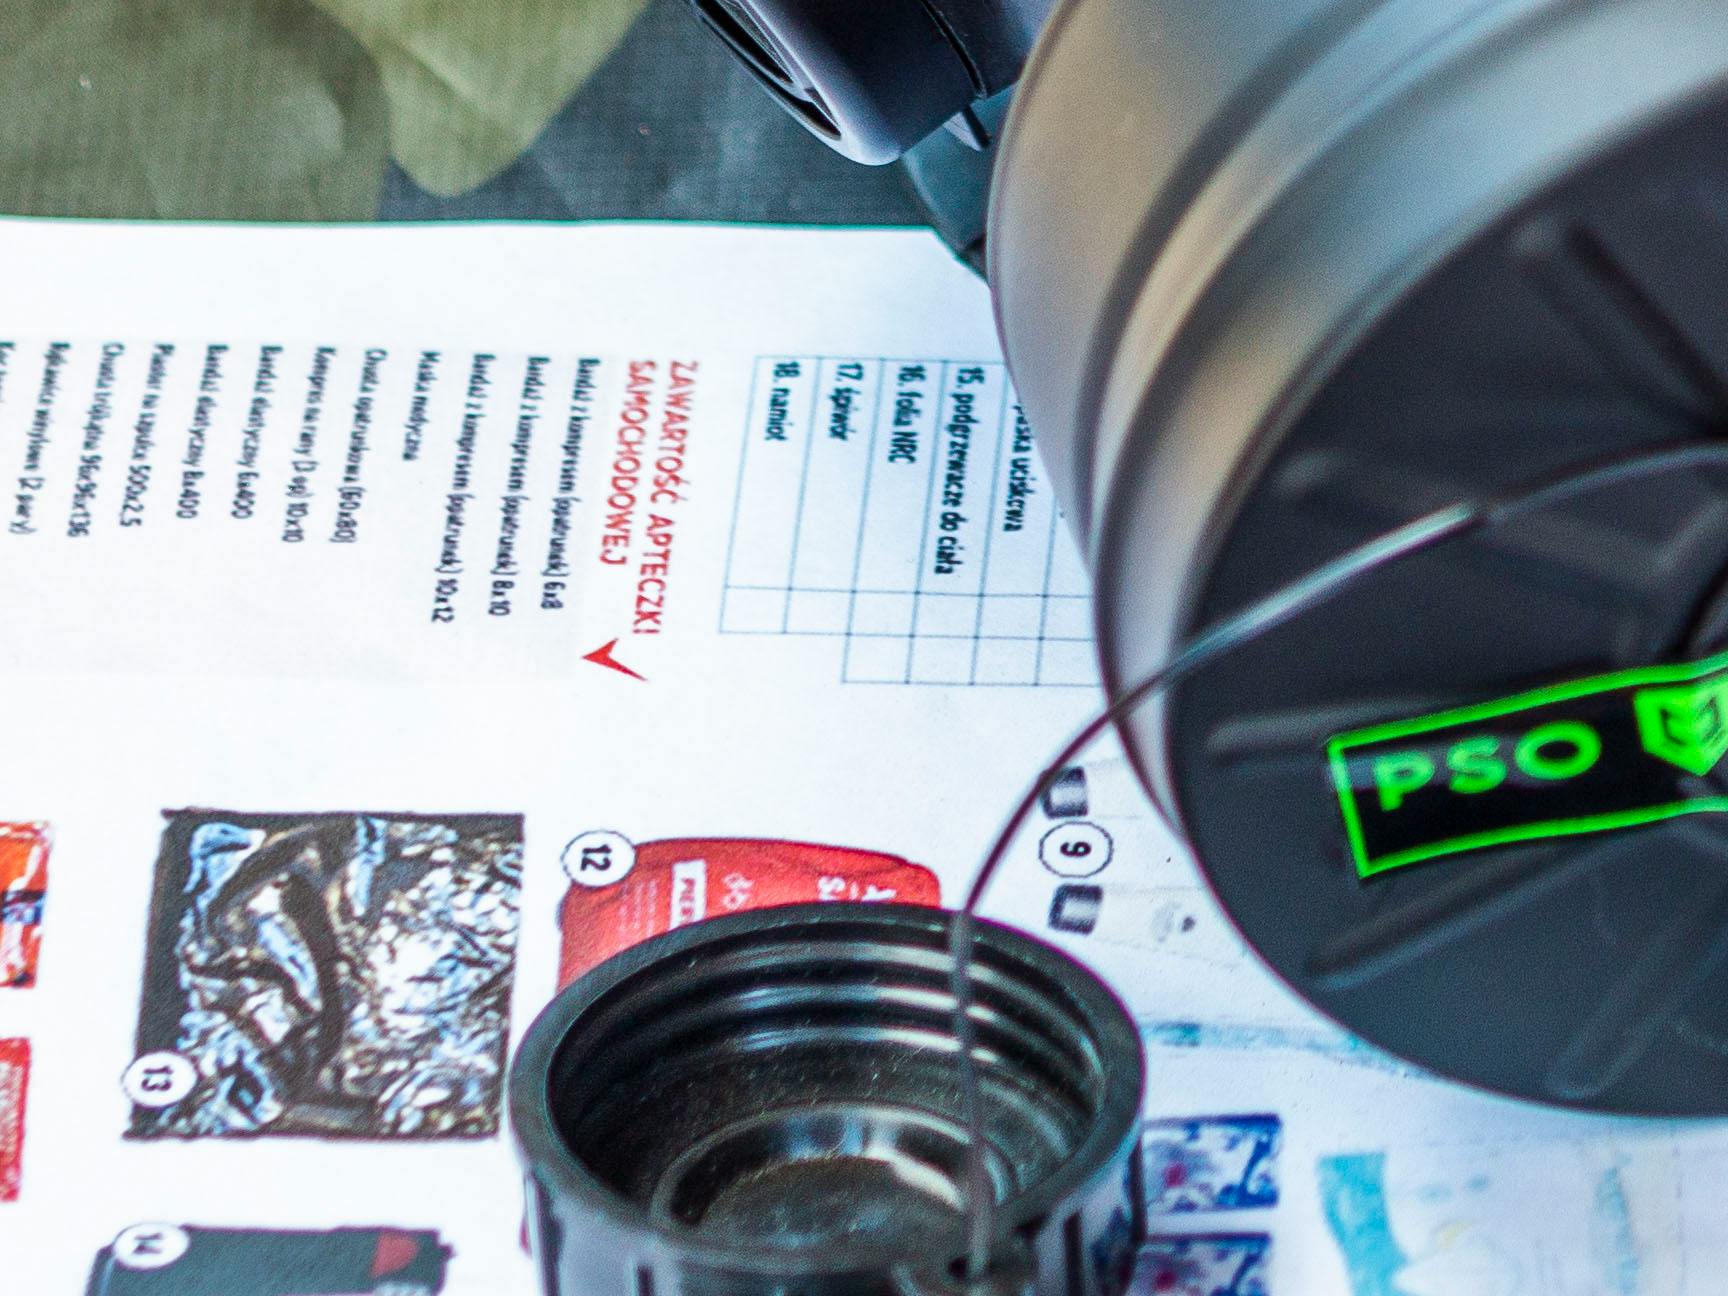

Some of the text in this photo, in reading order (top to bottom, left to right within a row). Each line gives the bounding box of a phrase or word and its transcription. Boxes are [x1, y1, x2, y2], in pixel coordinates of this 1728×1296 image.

[96, 342, 125, 388] Chusta
[200, 344, 229, 392] Bandaż
[254, 345, 283, 392] Bandaż
[307, 346, 336, 404] Kompres
[359, 349, 388, 393] Chusta
[415, 351, 440, 392] Maska
[467, 353, 496, 398] Bandaż
[522, 356, 550, 400] Bandaż
[572, 358, 601, 401] Bandaż
[303, 407, 320, 422] na
[465, 402, 482, 410] z
[765, 361, 800, 441] 18. namiot
[829, 362, 864, 441] 17. śpiwór
[888, 364, 926, 463] 16. folia NRC
[182, 396, 216, 467] elastyczny
[237, 396, 271, 468] elastyczny
[294, 425, 316, 456] rany
[453, 413, 484, 490] kompresem
[508, 415, 539, 492] kompresem
[559, 416, 590, 493] kompresem
[646, 360, 698, 503] ZAWARTOŚĆ
[600, 360, 656, 565] SAMOCHODOWEJ
[934, 367, 985, 574] 15. podgrzewacze do ciała
[282, 502, 309, 543] 10x10
[1003, 457, 1036, 532] uciskowa
[435, 494, 474, 574] (opatrunek)
[490, 496, 529, 576] (opatrunek)
[542, 497, 580, 577] (opatrunek)
[488, 580, 514, 616] 8x10
[541, 582, 566, 609] 6x8
[1372, 719, 1602, 810] PSO
[580, 843, 612, 872] 12
[140, 1064, 174, 1094] 13
